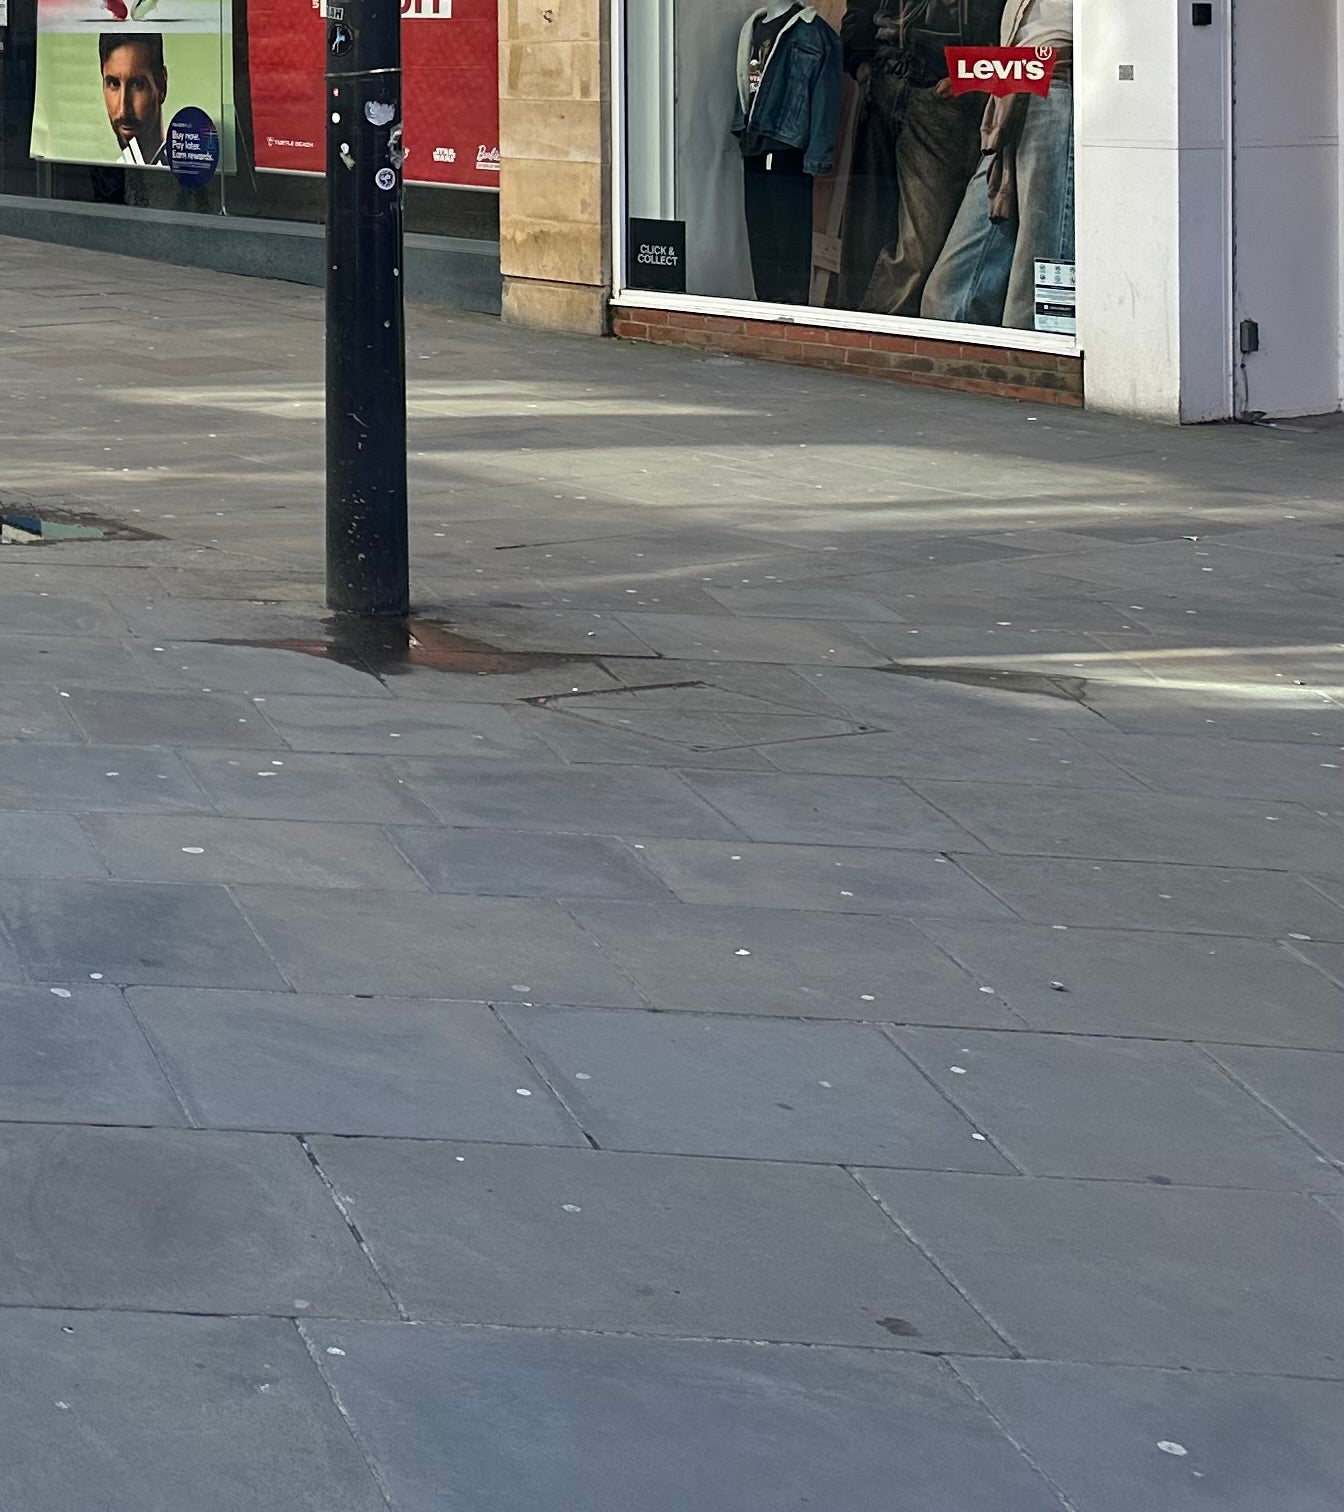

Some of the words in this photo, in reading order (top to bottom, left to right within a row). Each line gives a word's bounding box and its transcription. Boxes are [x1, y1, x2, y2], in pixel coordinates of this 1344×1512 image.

[172, 130, 184, 141] Buy
[172, 140, 184, 151] Pay
[640, 244, 667, 255] CLICK
[668, 246, 675, 256] &
[637, 253, 678, 266] COLLECT
